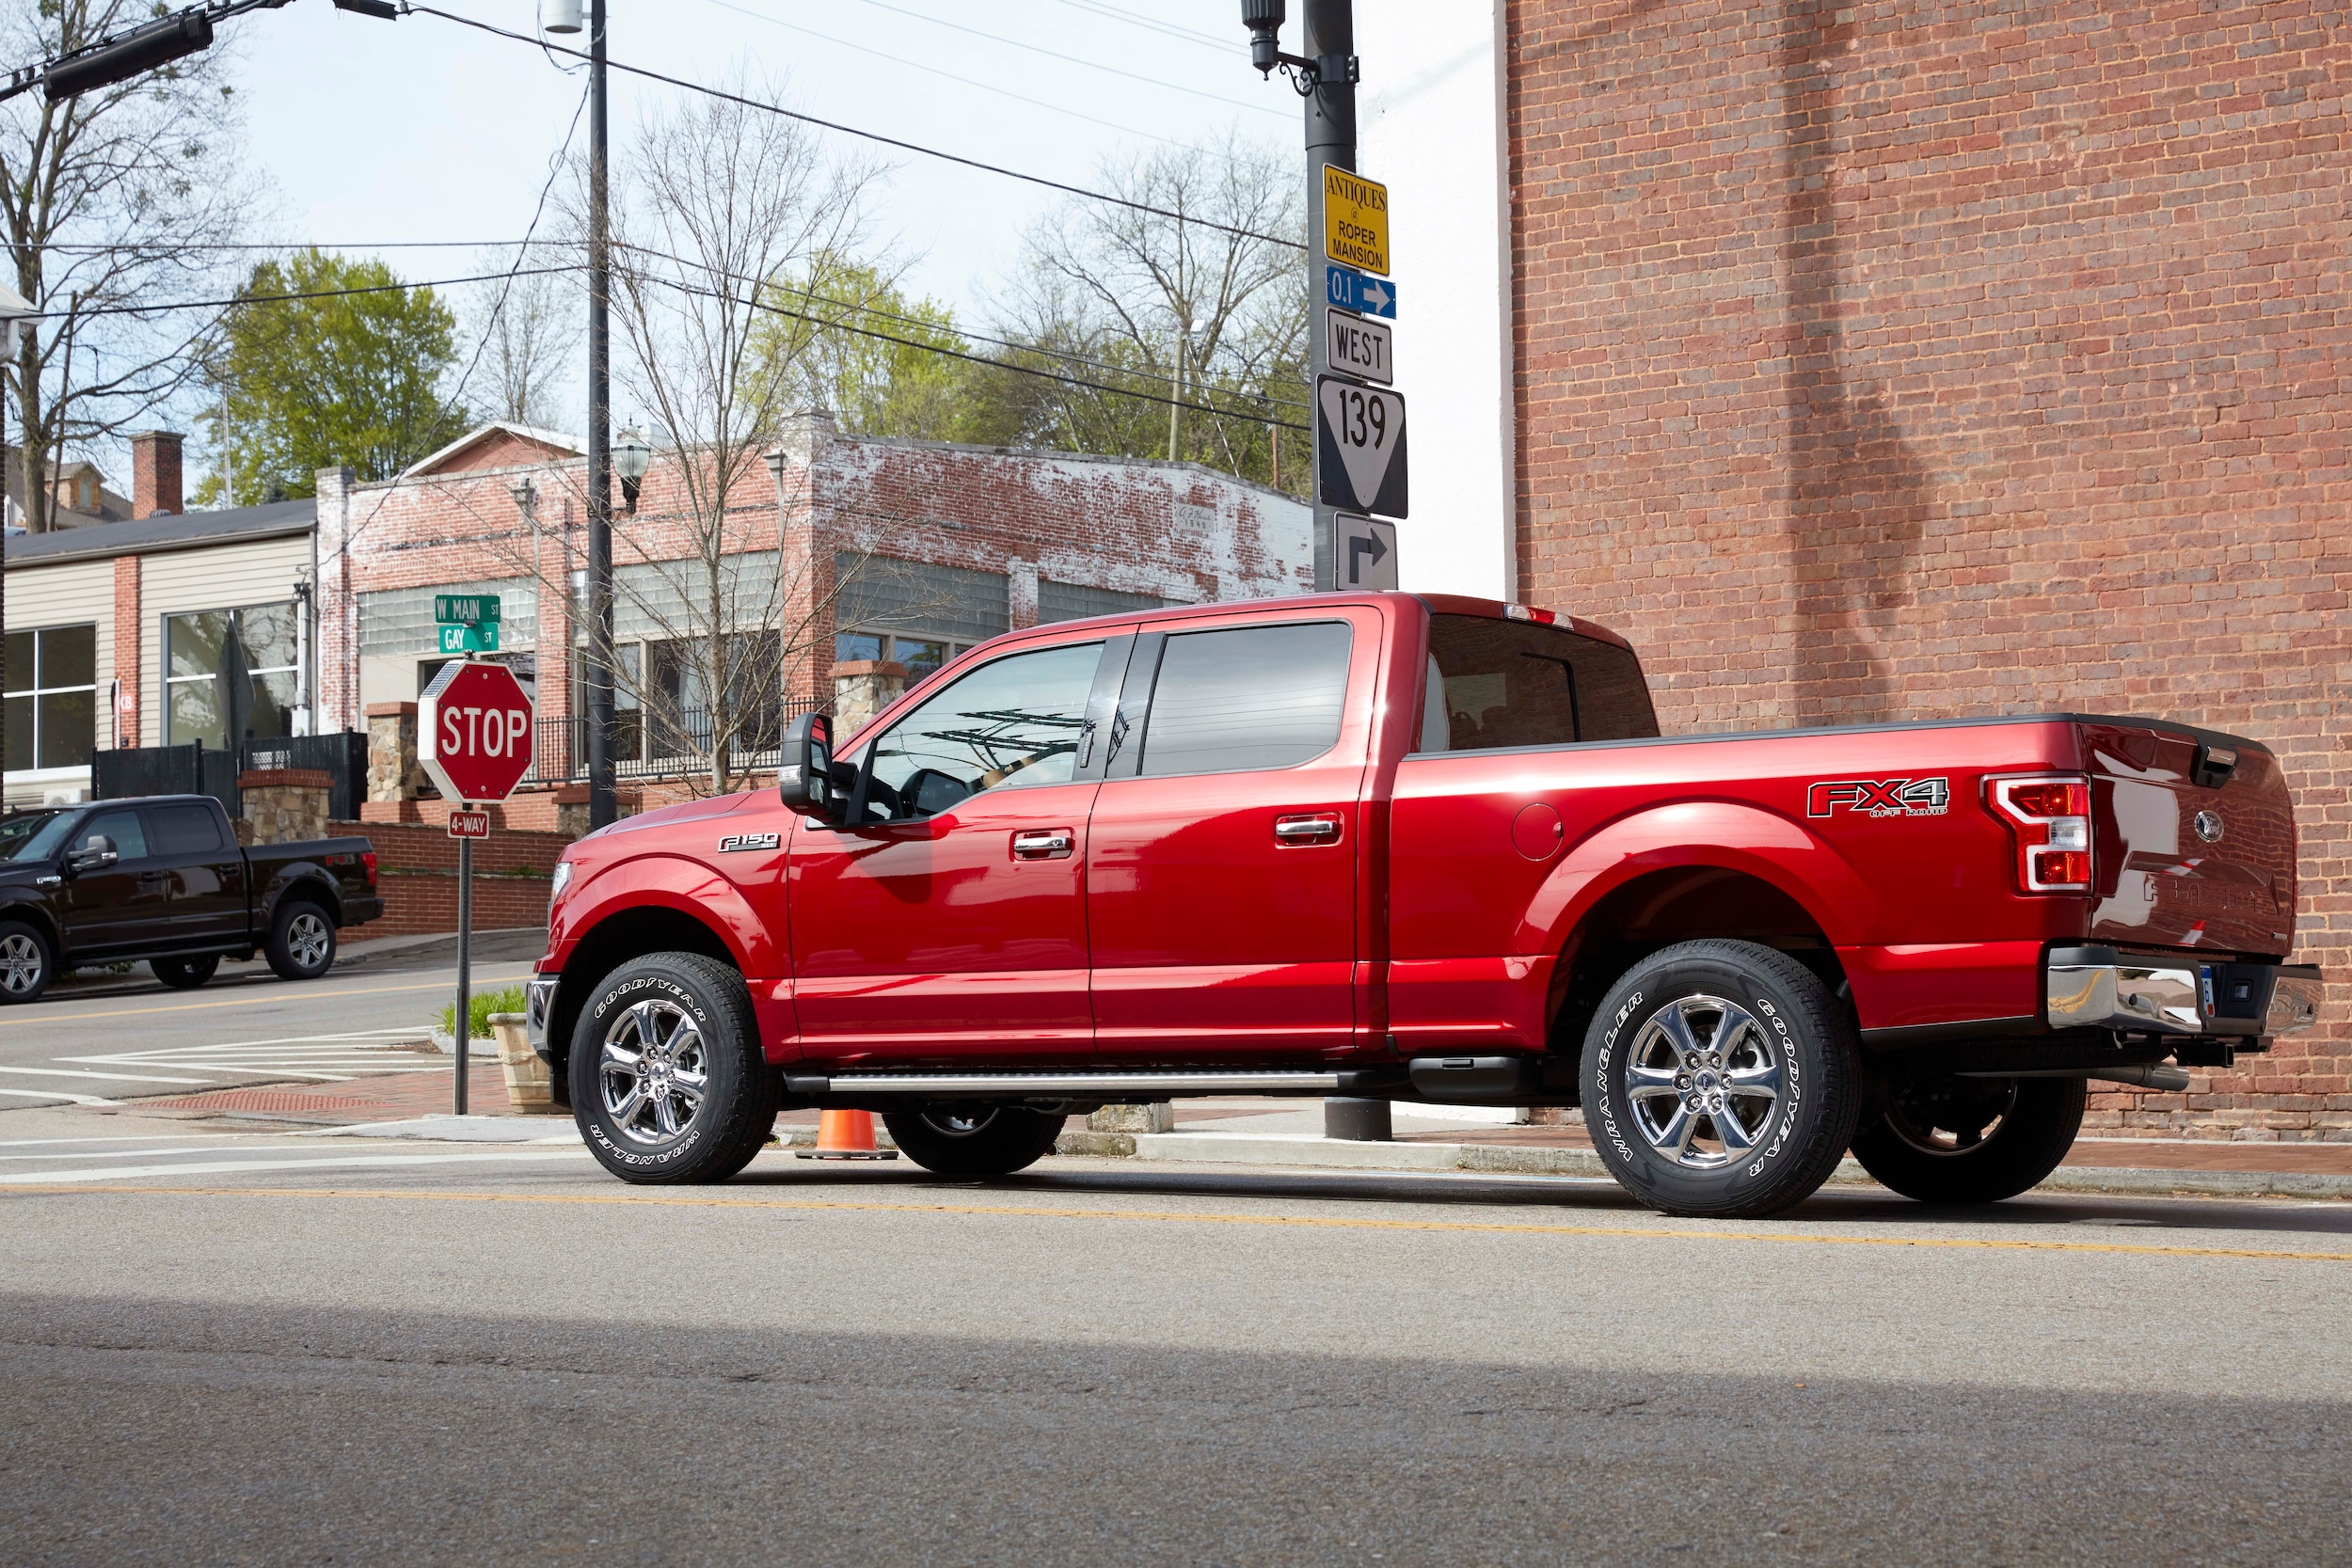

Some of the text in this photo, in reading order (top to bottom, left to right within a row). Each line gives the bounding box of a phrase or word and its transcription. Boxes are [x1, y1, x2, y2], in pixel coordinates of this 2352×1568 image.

[1327, 175, 1386, 212] ANTIQUES
[1339, 220, 1376, 247] ROPER
[1333, 238, 1383, 269] MANSION
[1336, 324, 1382, 370] WEST
[1340, 389, 1386, 450] 139
[437, 599, 500, 620] W MAIN ST
[445, 628, 493, 650] GAY ST
[441, 705, 527, 758] STOP
[1807, 777, 1949, 818] FX4
[1906, 808, 1947, 816] ROAD
[451, 816, 486, 833] 4-WAY
[1597, 991, 1644, 1163] WRANGLER
[591, 1123, 701, 1165] WRANGLER
